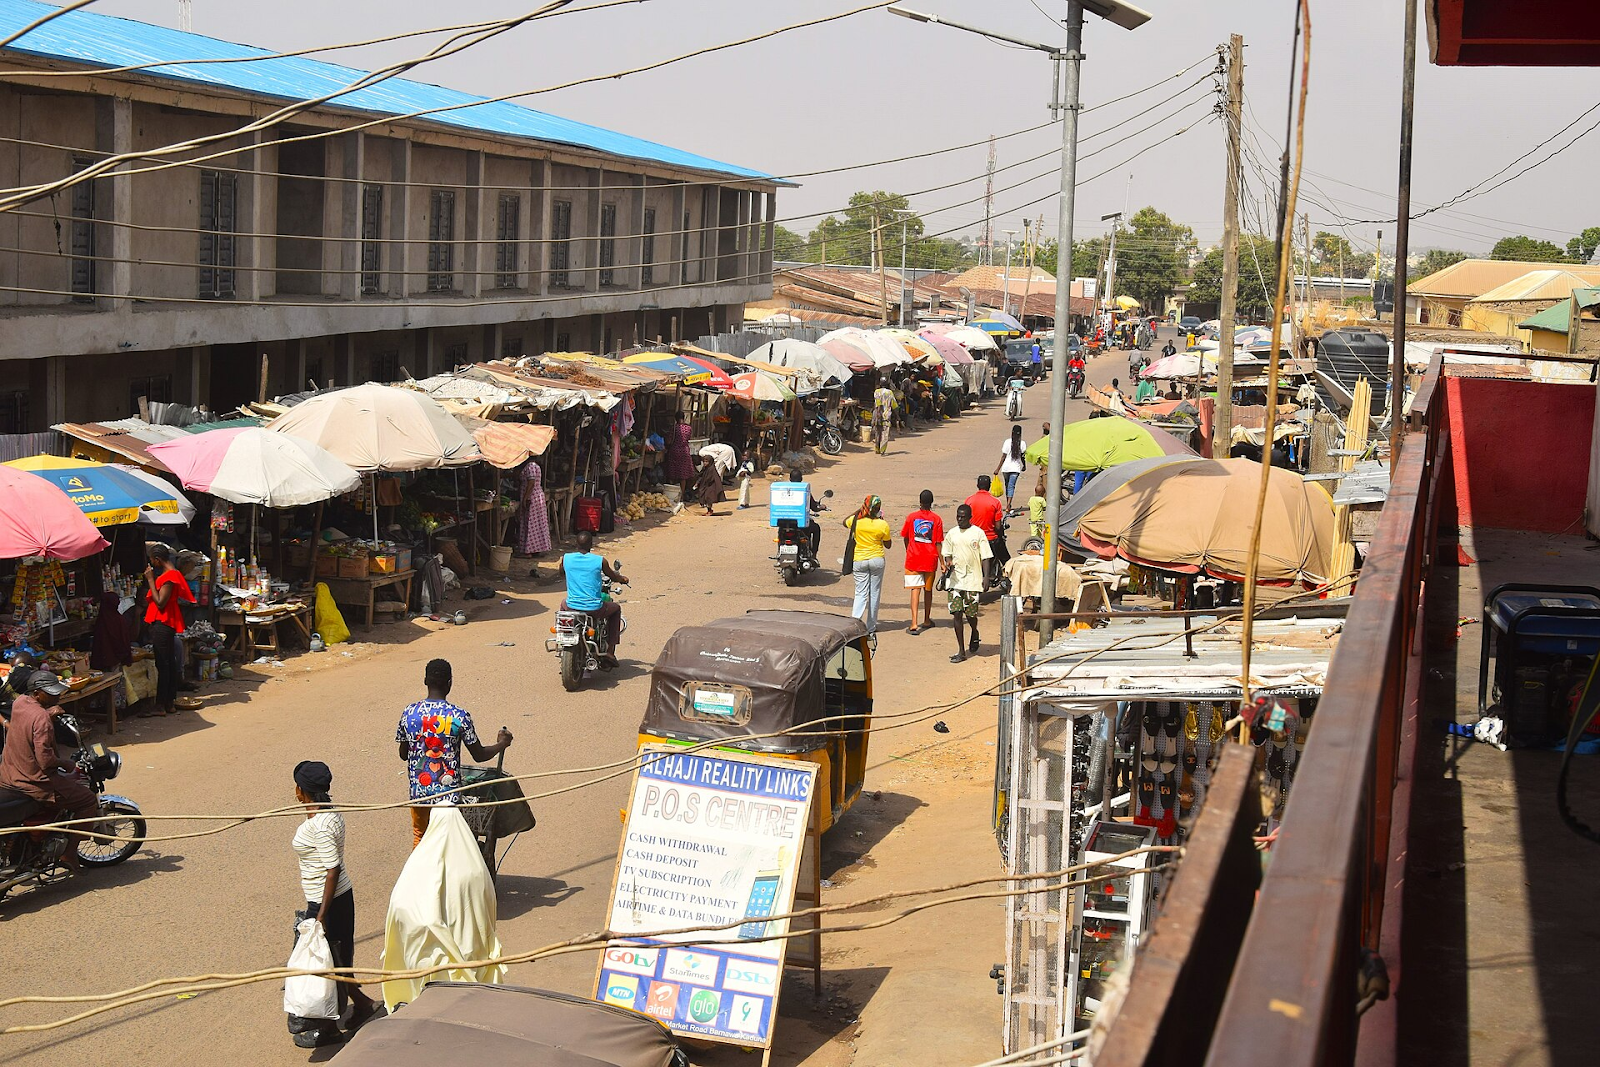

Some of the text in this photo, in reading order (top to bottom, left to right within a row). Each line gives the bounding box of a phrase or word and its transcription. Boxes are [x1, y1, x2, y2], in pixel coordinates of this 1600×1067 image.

[111, 513, 132, 522] start
[643, 752, 811, 797] ALHAJI REALITY LINKS
[641, 784, 798, 838] P.O.S CENTRE
[629, 832, 728, 856] CASH WITHDRAWAL
[626, 848, 699, 869] CASH DEPOSIT
[623, 865, 713, 888] TV SUBSCRIPTION
[619, 882, 738, 910] ELECTRICITY PAYMENT
[615, 899, 657, 914] AIRTIME
[658, 906, 667, 916] &
[669, 907, 693, 920] DATA
[606, 949, 656, 968] GOtv
[669, 966, 710, 981] StarTimes
[726, 968, 776, 985] DStv
[611, 987, 630, 998] MTN
[647, 1005, 673, 1017] airtel
[693, 997, 714, 1015] glo
[665, 1020, 688, 1031] Market
[689, 1023, 708, 1034] Road
